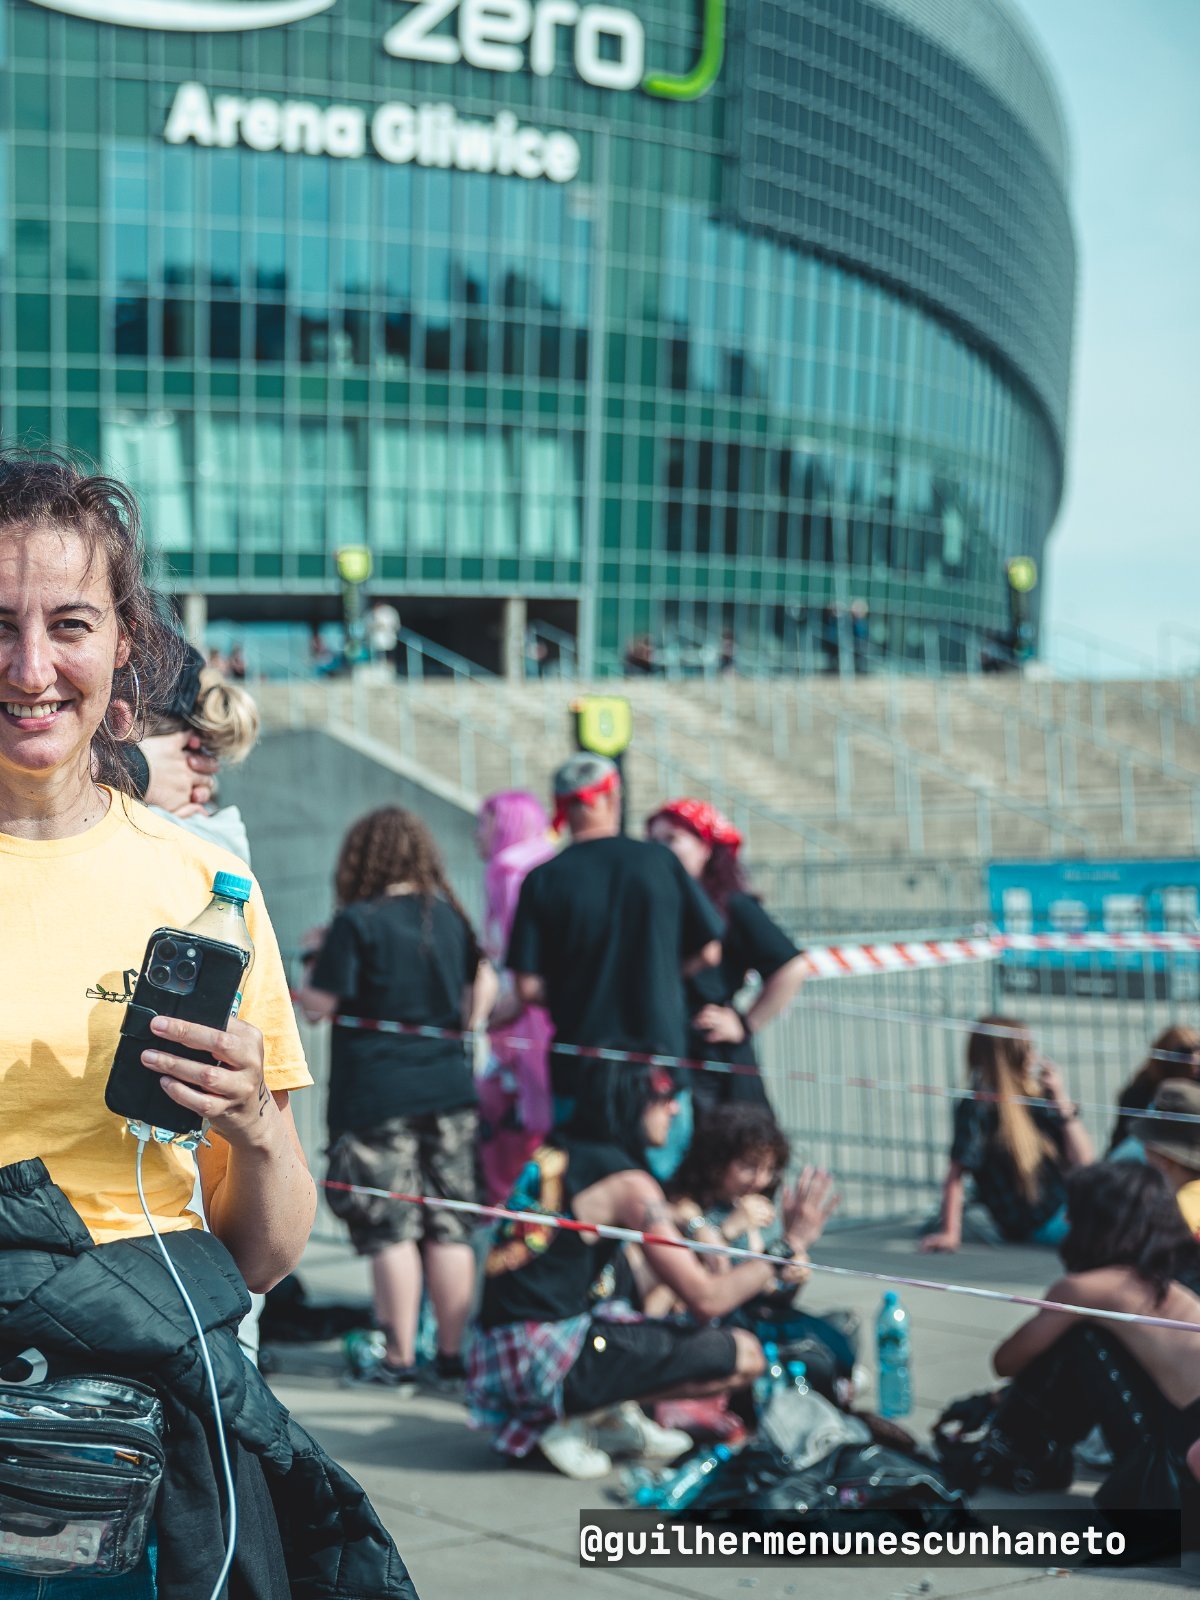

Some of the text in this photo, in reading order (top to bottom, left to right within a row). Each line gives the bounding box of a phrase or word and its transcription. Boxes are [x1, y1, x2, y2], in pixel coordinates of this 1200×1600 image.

[383, 0, 645, 90] zero
[165, 82, 580, 181] Arena Gliwice
